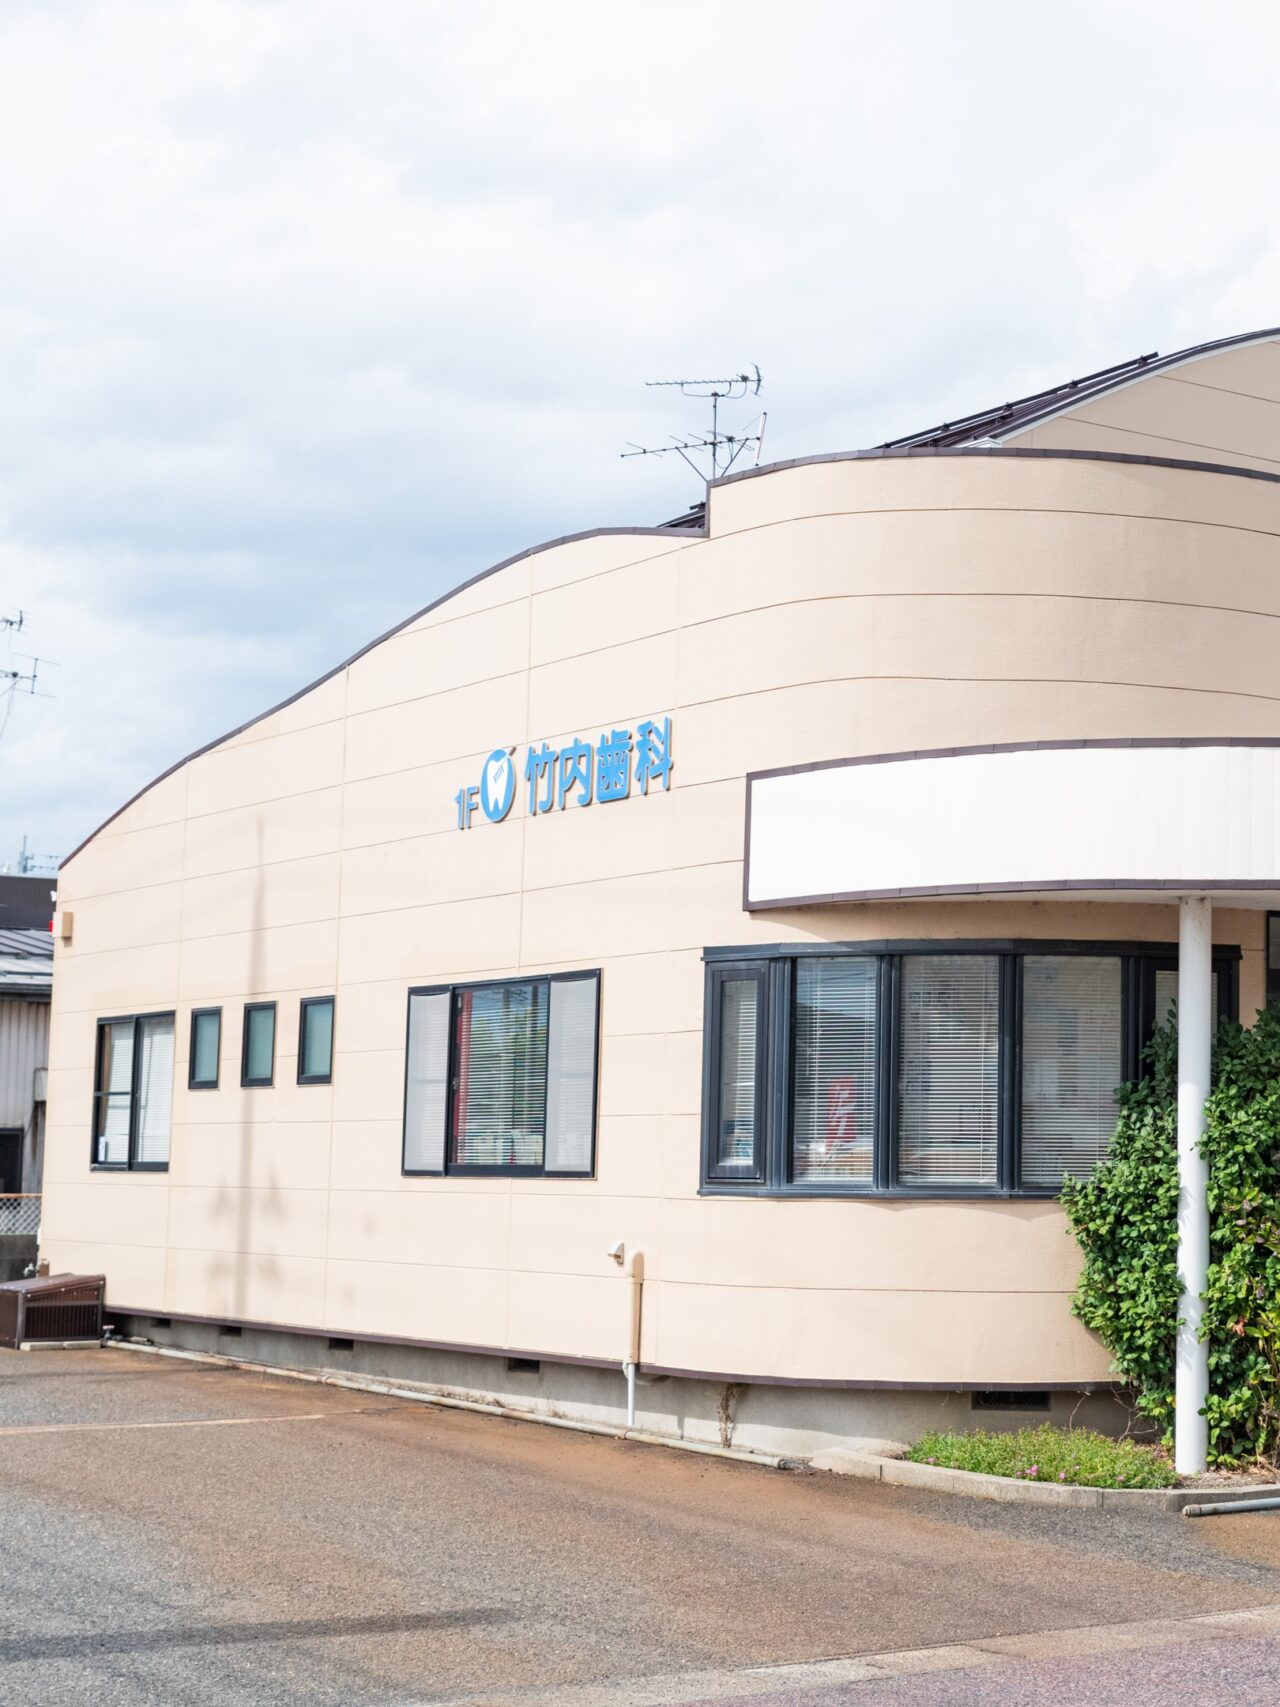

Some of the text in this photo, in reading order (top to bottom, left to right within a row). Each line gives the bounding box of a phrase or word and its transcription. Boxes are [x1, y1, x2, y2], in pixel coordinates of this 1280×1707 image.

[454, 716, 673, 830] 1F 竹内歯科
